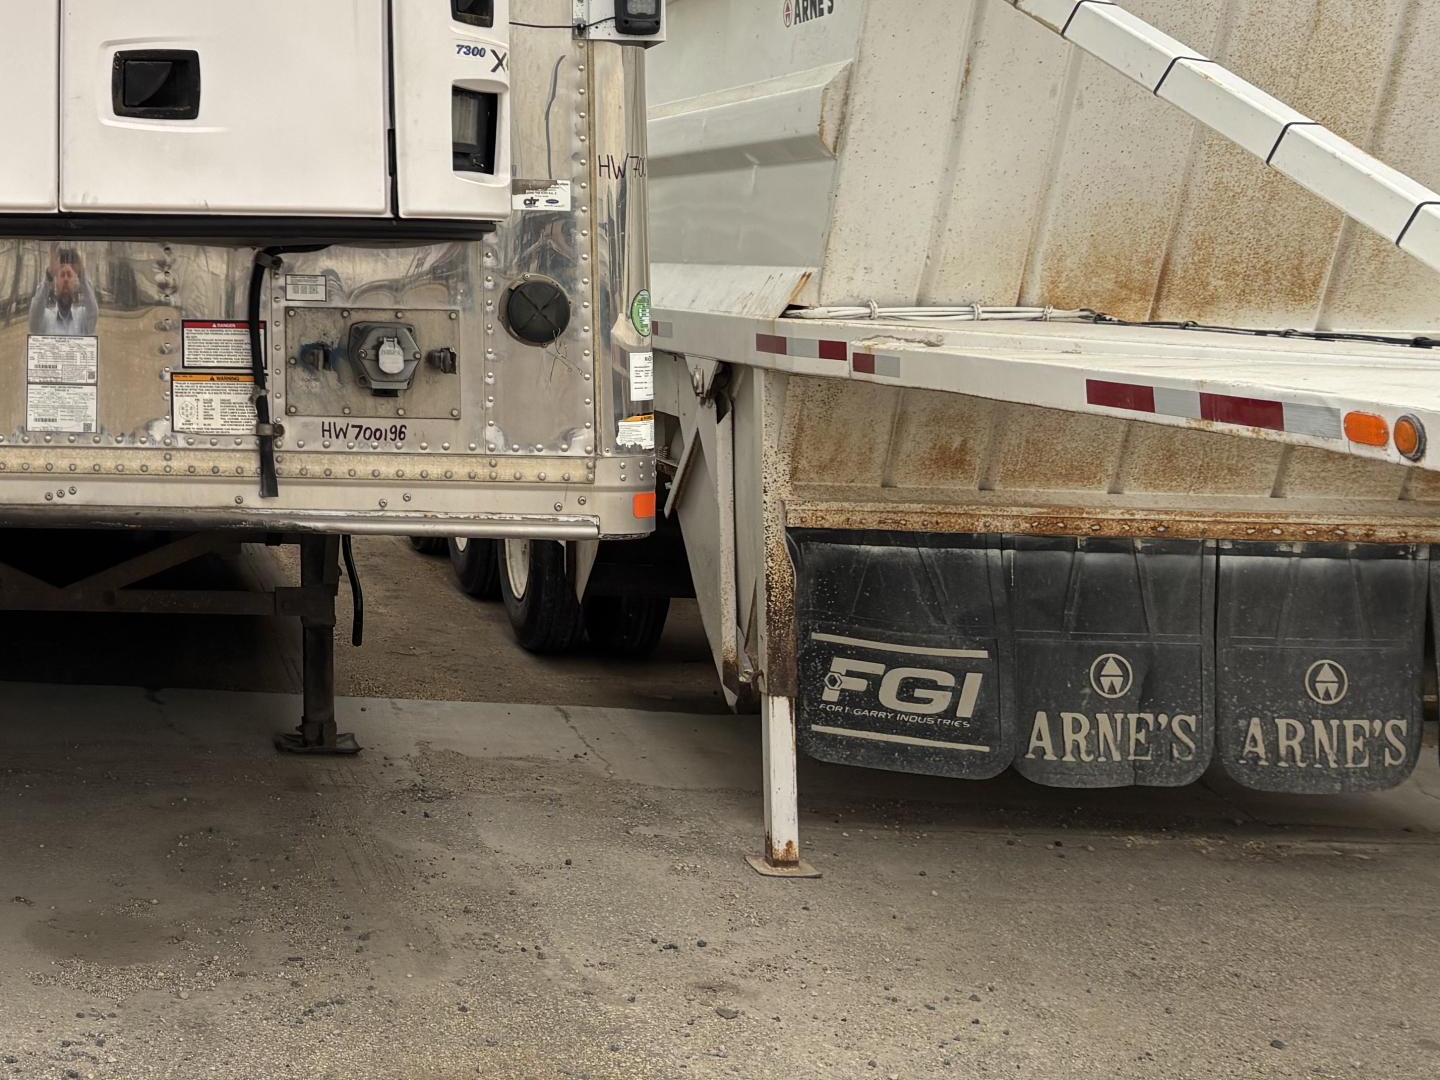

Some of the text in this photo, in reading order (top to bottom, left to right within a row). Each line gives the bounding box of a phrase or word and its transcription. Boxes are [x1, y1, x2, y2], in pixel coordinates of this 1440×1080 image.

[455, 44, 509, 73] 7300 X
[321, 421, 407, 442] HW700196
[821, 656, 983, 719] FGI
[818, 703, 972, 729] FORT GARRY INDUSTRIES
[1024, 710, 1198, 764] ARNE'S
[1237, 716, 1408, 770] ARNE'S
